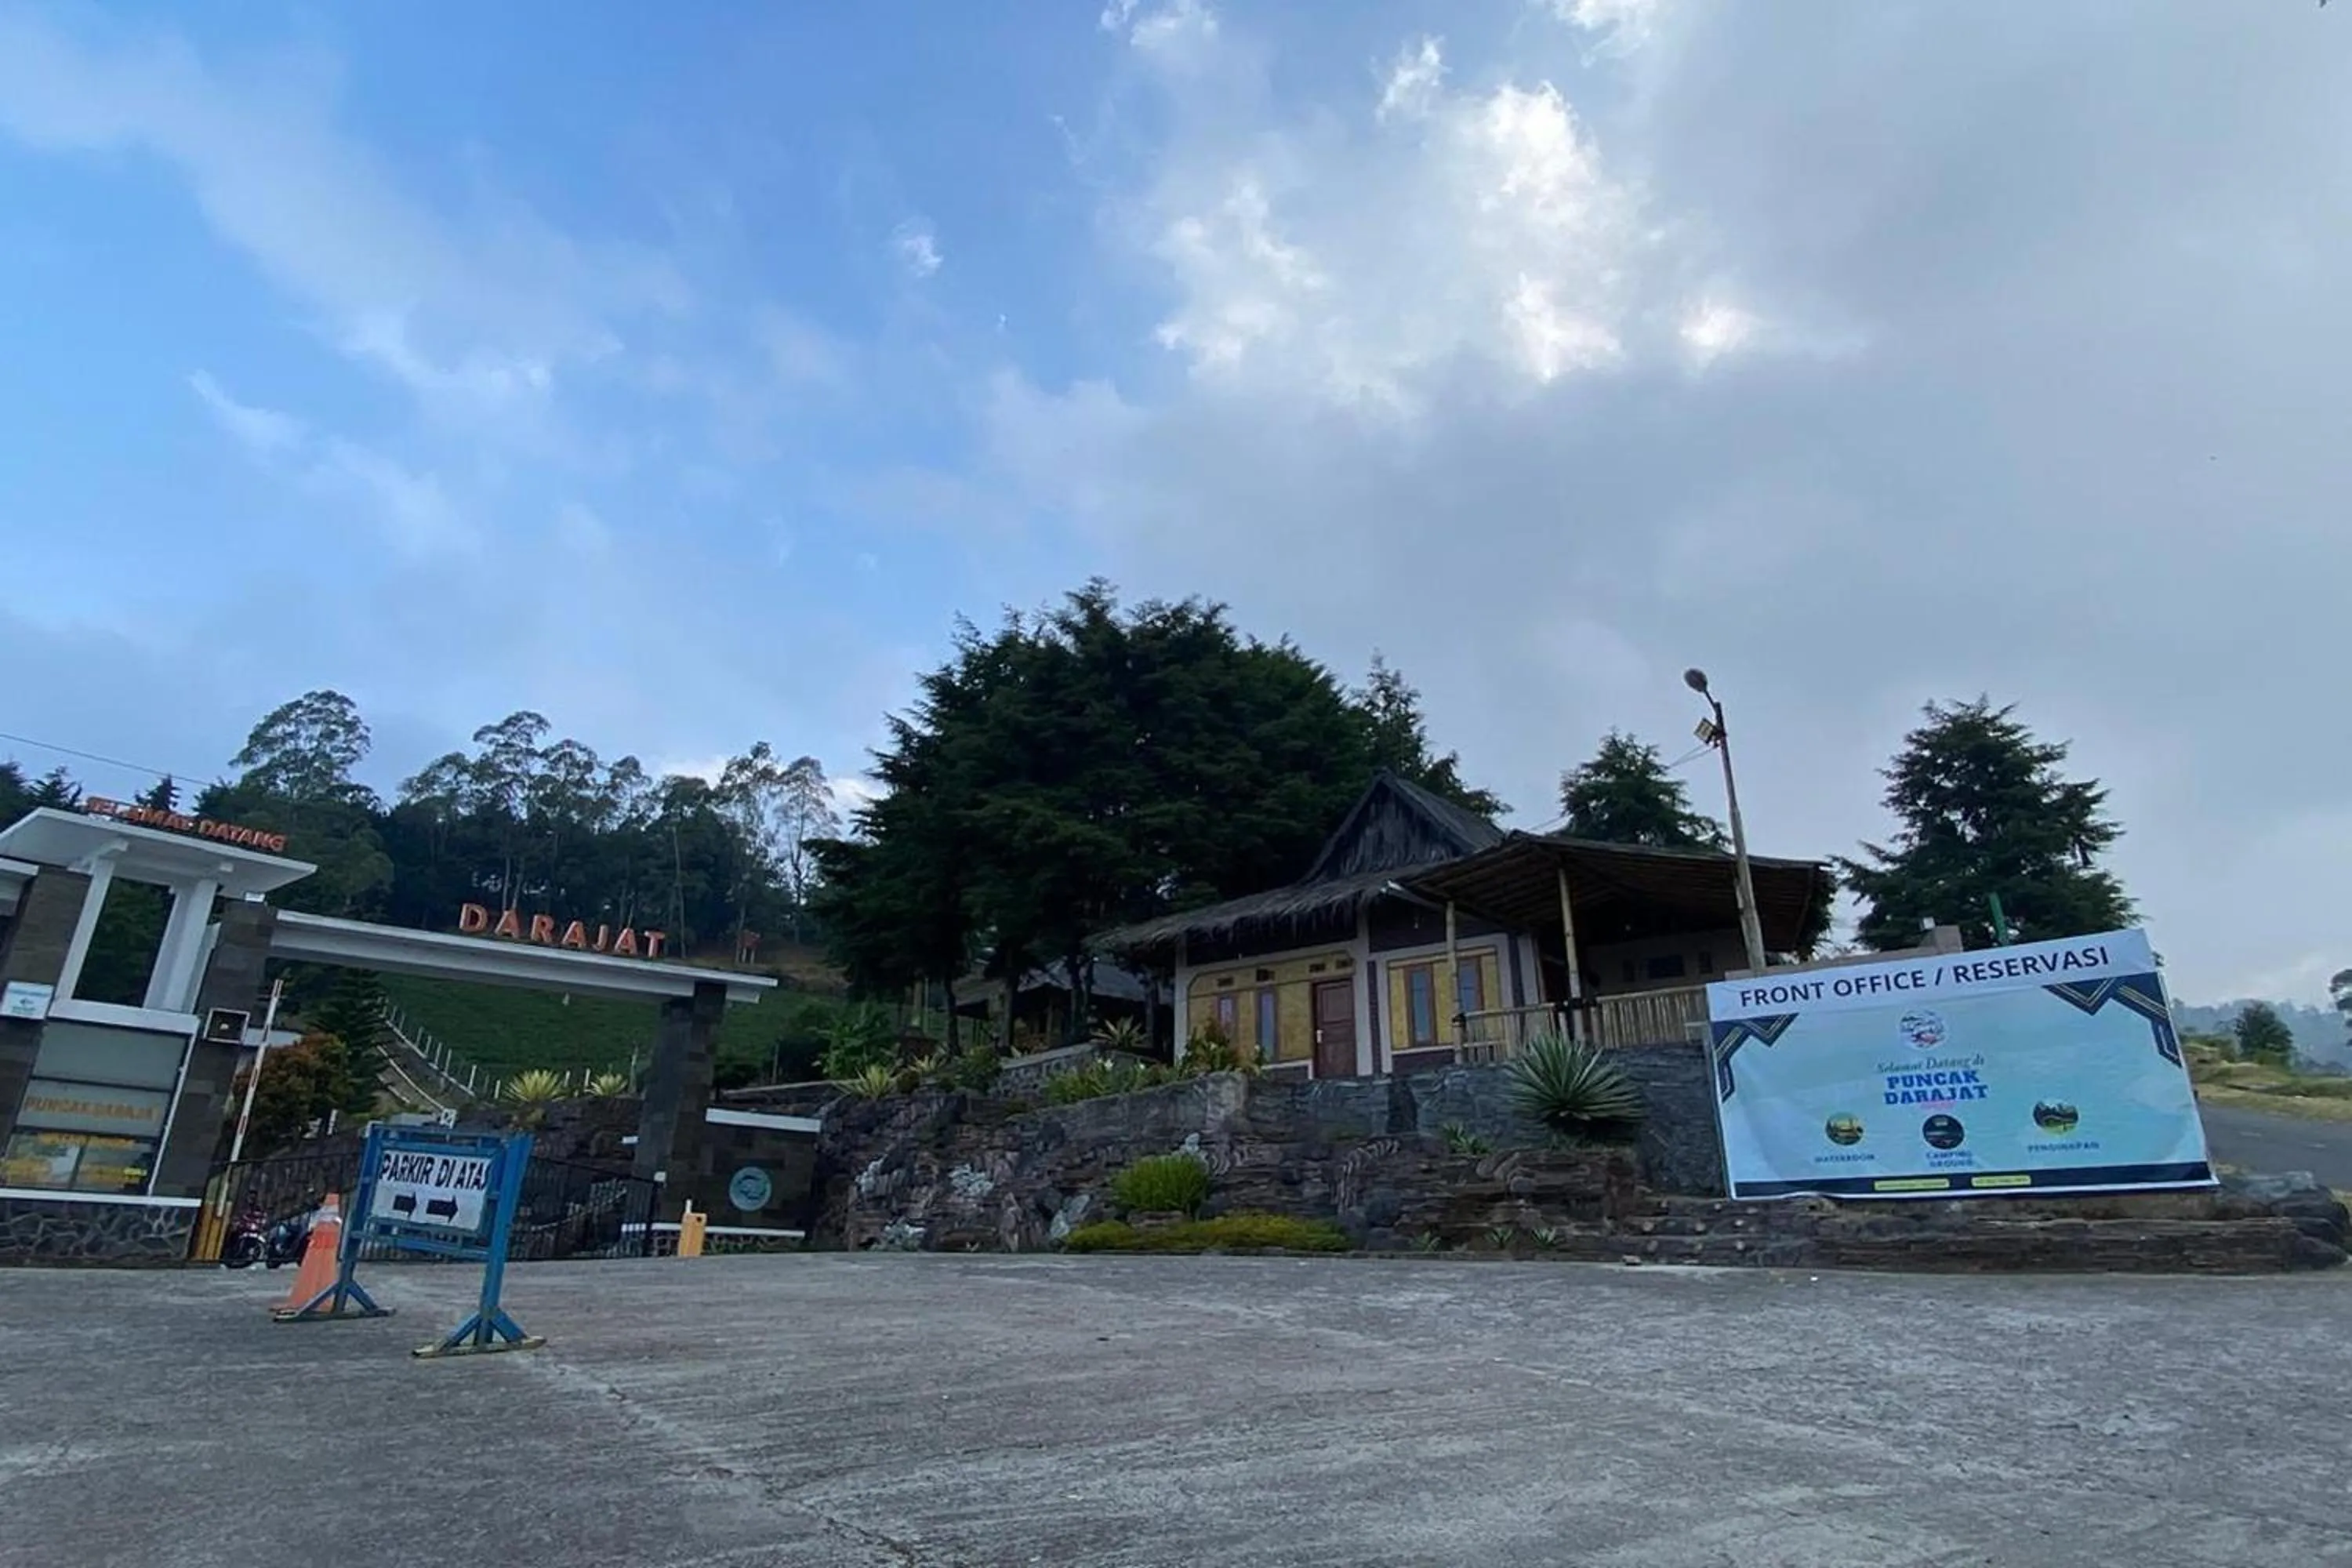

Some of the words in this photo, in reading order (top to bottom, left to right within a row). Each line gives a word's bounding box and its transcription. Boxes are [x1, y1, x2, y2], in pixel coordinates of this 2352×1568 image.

[199, 819, 288, 852] DATANG
[459, 902, 666, 958] DARAJAT
[1740, 982, 1825, 1007] FRONT
[1833, 970, 1926, 997] OFFICE
[1934, 967, 1944, 986] /
[1952, 946, 2109, 983] RESERVASI
[1883, 1084, 1989, 1105] DARAJAT
[1886, 1069, 1980, 1090] PUNCAK
[379, 1153, 435, 1185] PARKIR
[435, 1158, 457, 1189] DI
